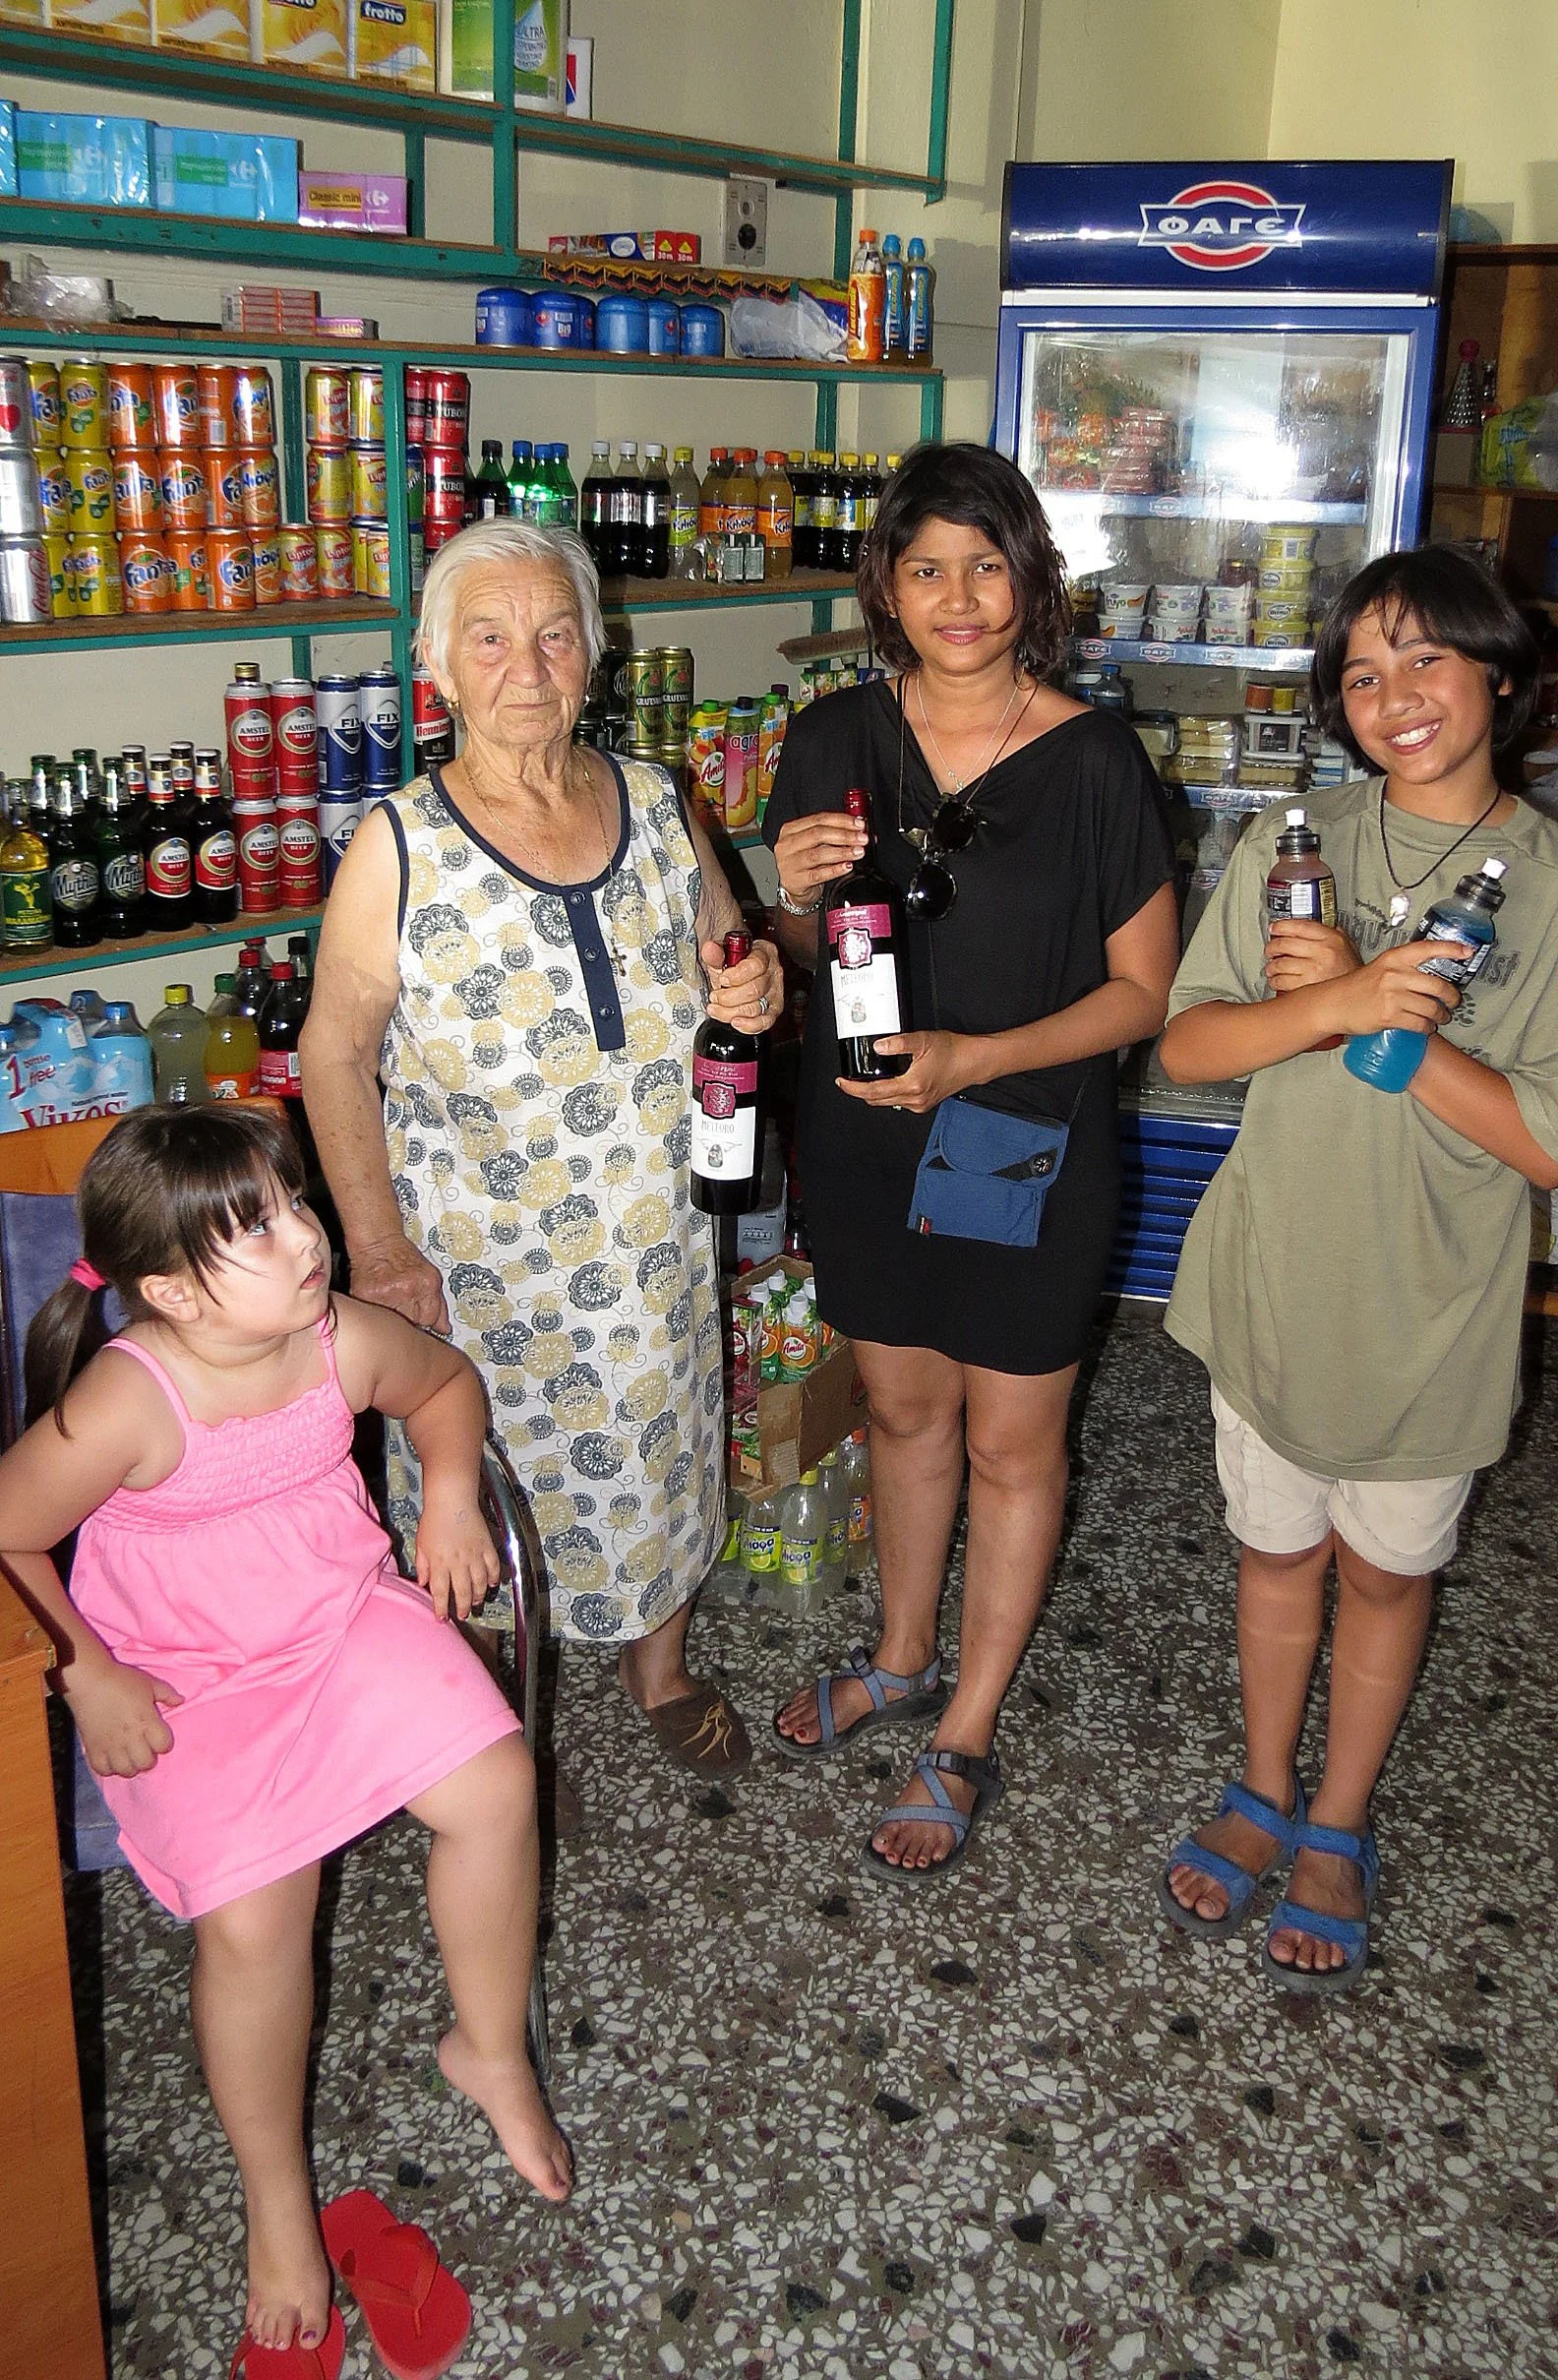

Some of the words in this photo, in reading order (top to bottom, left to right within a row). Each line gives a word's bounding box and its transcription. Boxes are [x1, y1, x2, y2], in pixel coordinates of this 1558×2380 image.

[364, 2, 404, 23] frotto
[125, 559, 179, 588] Fanta
[377, 712, 399, 723] FIX
[341, 829, 354, 838] FI
[6, 1054, 28, 1100] 1
[783, 1341, 805, 1355] Amita
